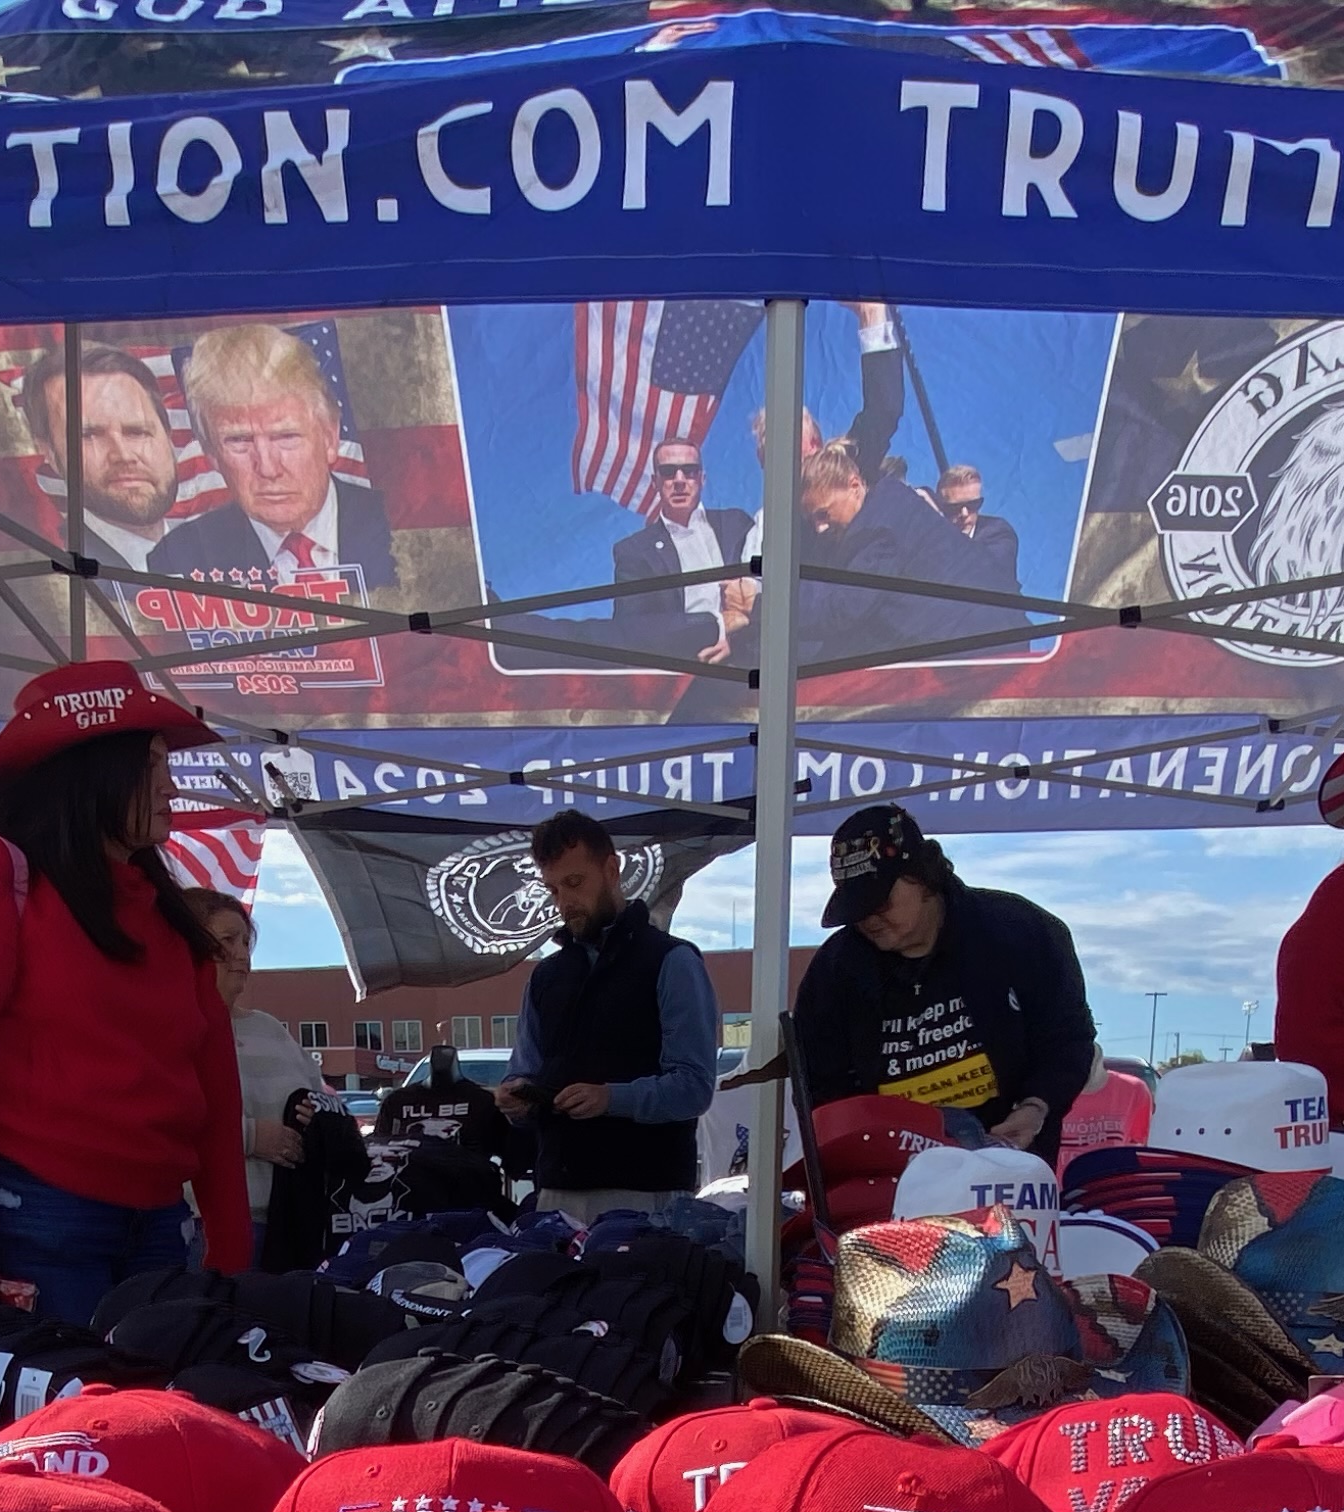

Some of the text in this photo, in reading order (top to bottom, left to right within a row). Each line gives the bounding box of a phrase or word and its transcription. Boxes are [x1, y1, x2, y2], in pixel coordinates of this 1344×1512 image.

[53, 686, 127, 717] TRUMP
[75, 708, 117, 730] Girl
[949, 996, 966, 1013] m
[918, 1015, 974, 1046] freed
[887, 1059, 902, 1076] &
[957, 1064, 993, 1084] KEE
[438, 1103, 469, 1116] BE
[1284, 1096, 1327, 1122] TEA
[899, 1130, 945, 1152] TRU
[1274, 1122, 1329, 1149] TRU
[970, 1183, 1058, 1210] TEAM
